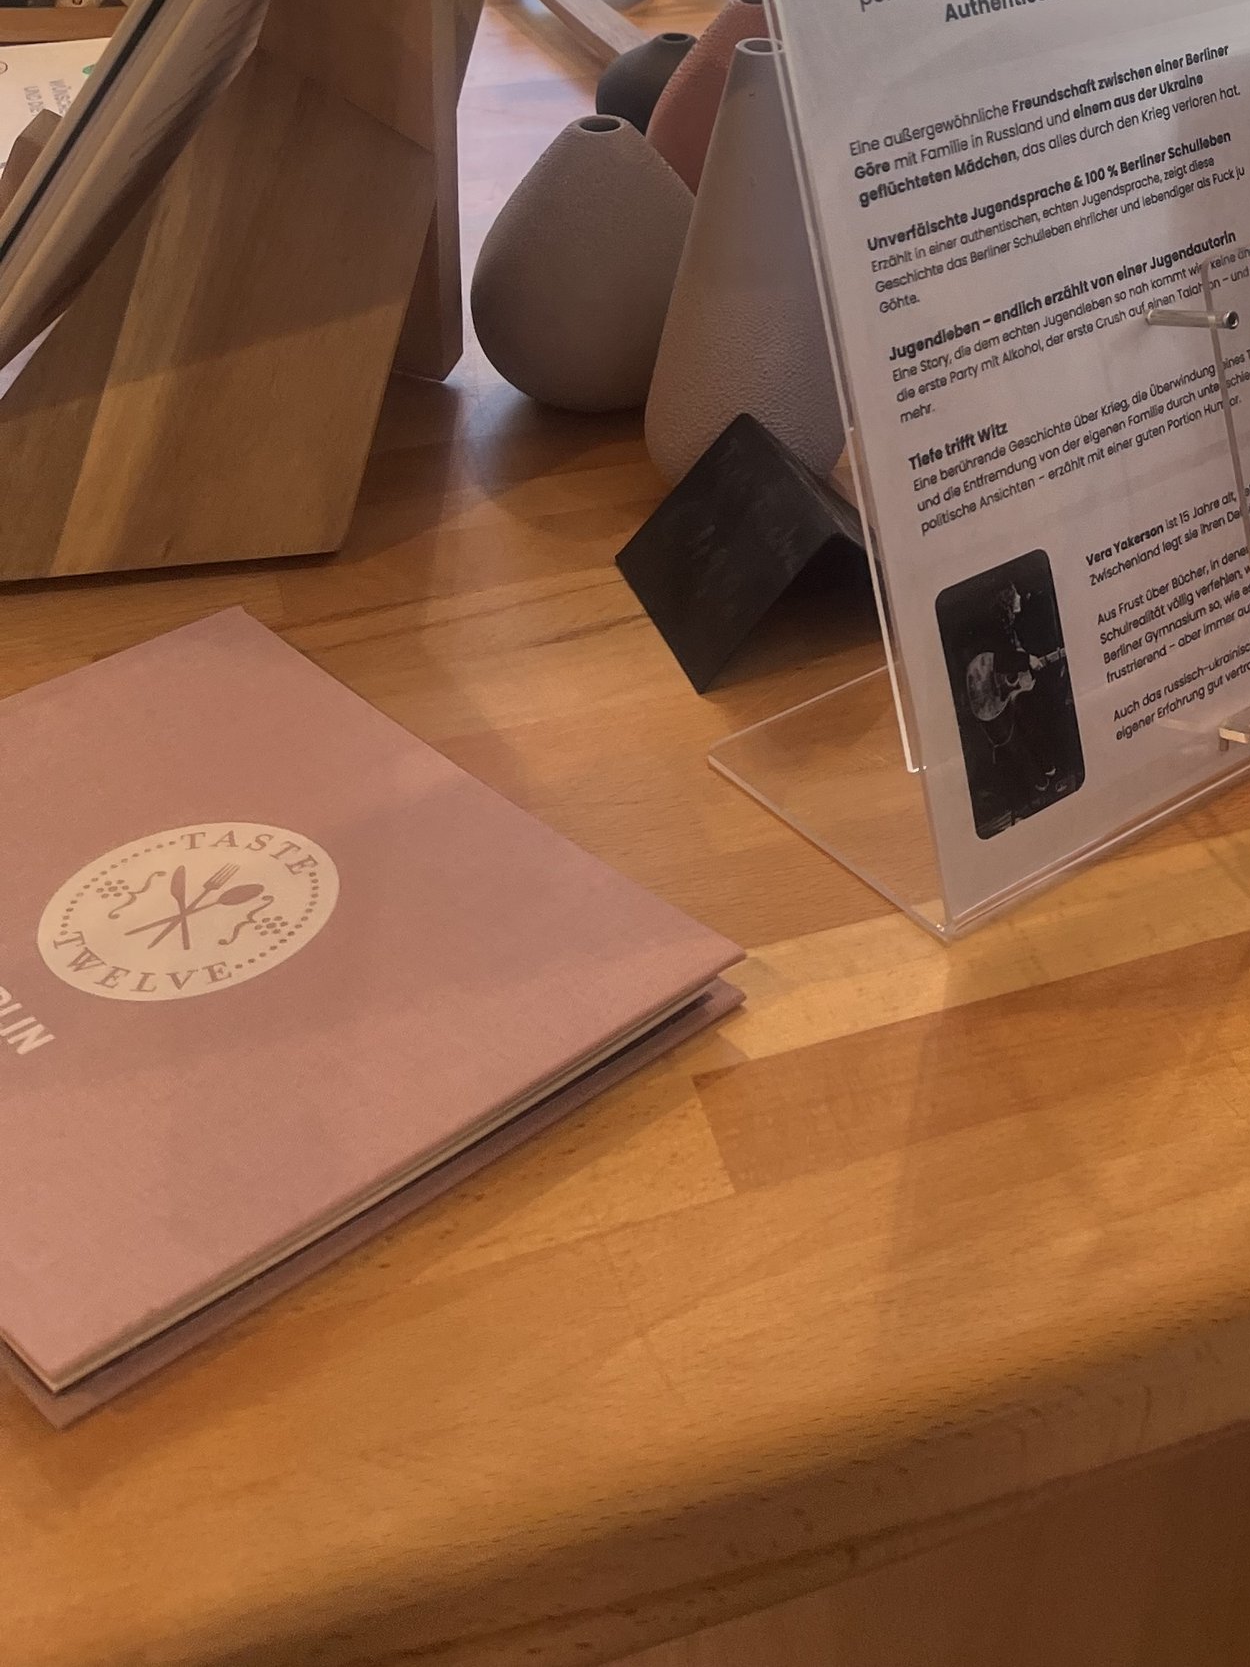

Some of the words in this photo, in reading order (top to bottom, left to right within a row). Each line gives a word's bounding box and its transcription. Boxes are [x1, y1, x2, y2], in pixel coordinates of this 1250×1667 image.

[849, 139, 880, 157] Eine
[883, 104, 1009, 148] außergewöhnliche
[1011, 78, 1097, 113] Freundschaft
[1097, 66, 1153, 90] zwischen
[1154, 57, 1184, 74] einer
[1185, 45, 1229, 66] Berliner
[854, 161, 891, 180] Göre
[894, 152, 918, 170] mit
[920, 138, 969, 162] Familie
[970, 134, 984, 148] in
[985, 116, 1044, 144] Russland
[1046, 108, 1071, 127] und
[1072, 100, 1112, 120] einem
[1113, 93, 1136, 108] aus
[1137, 87, 1157, 102] der
[1158, 74, 1204, 95] Ukraine
[858, 168, 953, 208] geflüchteten
[953, 150, 1020, 177] Mädchen,
[1021, 141, 1046, 158] das
[1048, 132, 1077, 150] alles
[1079, 120, 1115, 141] durch
[1116, 114, 1140, 130] den
[1140, 105, 1171, 123] Krieg
[1172, 92, 1218, 114] verloren
[1218, 84, 1241, 100] hat.
[866, 212, 969, 252] Unverfälschte
[970, 180, 1072, 221] Jugendsprache
[1084, 167, 1106, 185] 100
[1119, 151, 1166, 175] Berliner
[1167, 132, 1232, 160] Schulleben
[889, 320, 981, 361] Jugendleben
[993, 296, 1043, 324] endlich
[1044, 280, 1090, 306] erzählt
[1089, 273, 1115, 290] von
[1116, 261, 1148, 282] einer
[1149, 230, 1237, 270] Jugendautorin
[180, 830, 319, 876] TASTE
[52, 931, 233, 993] TWELVE
